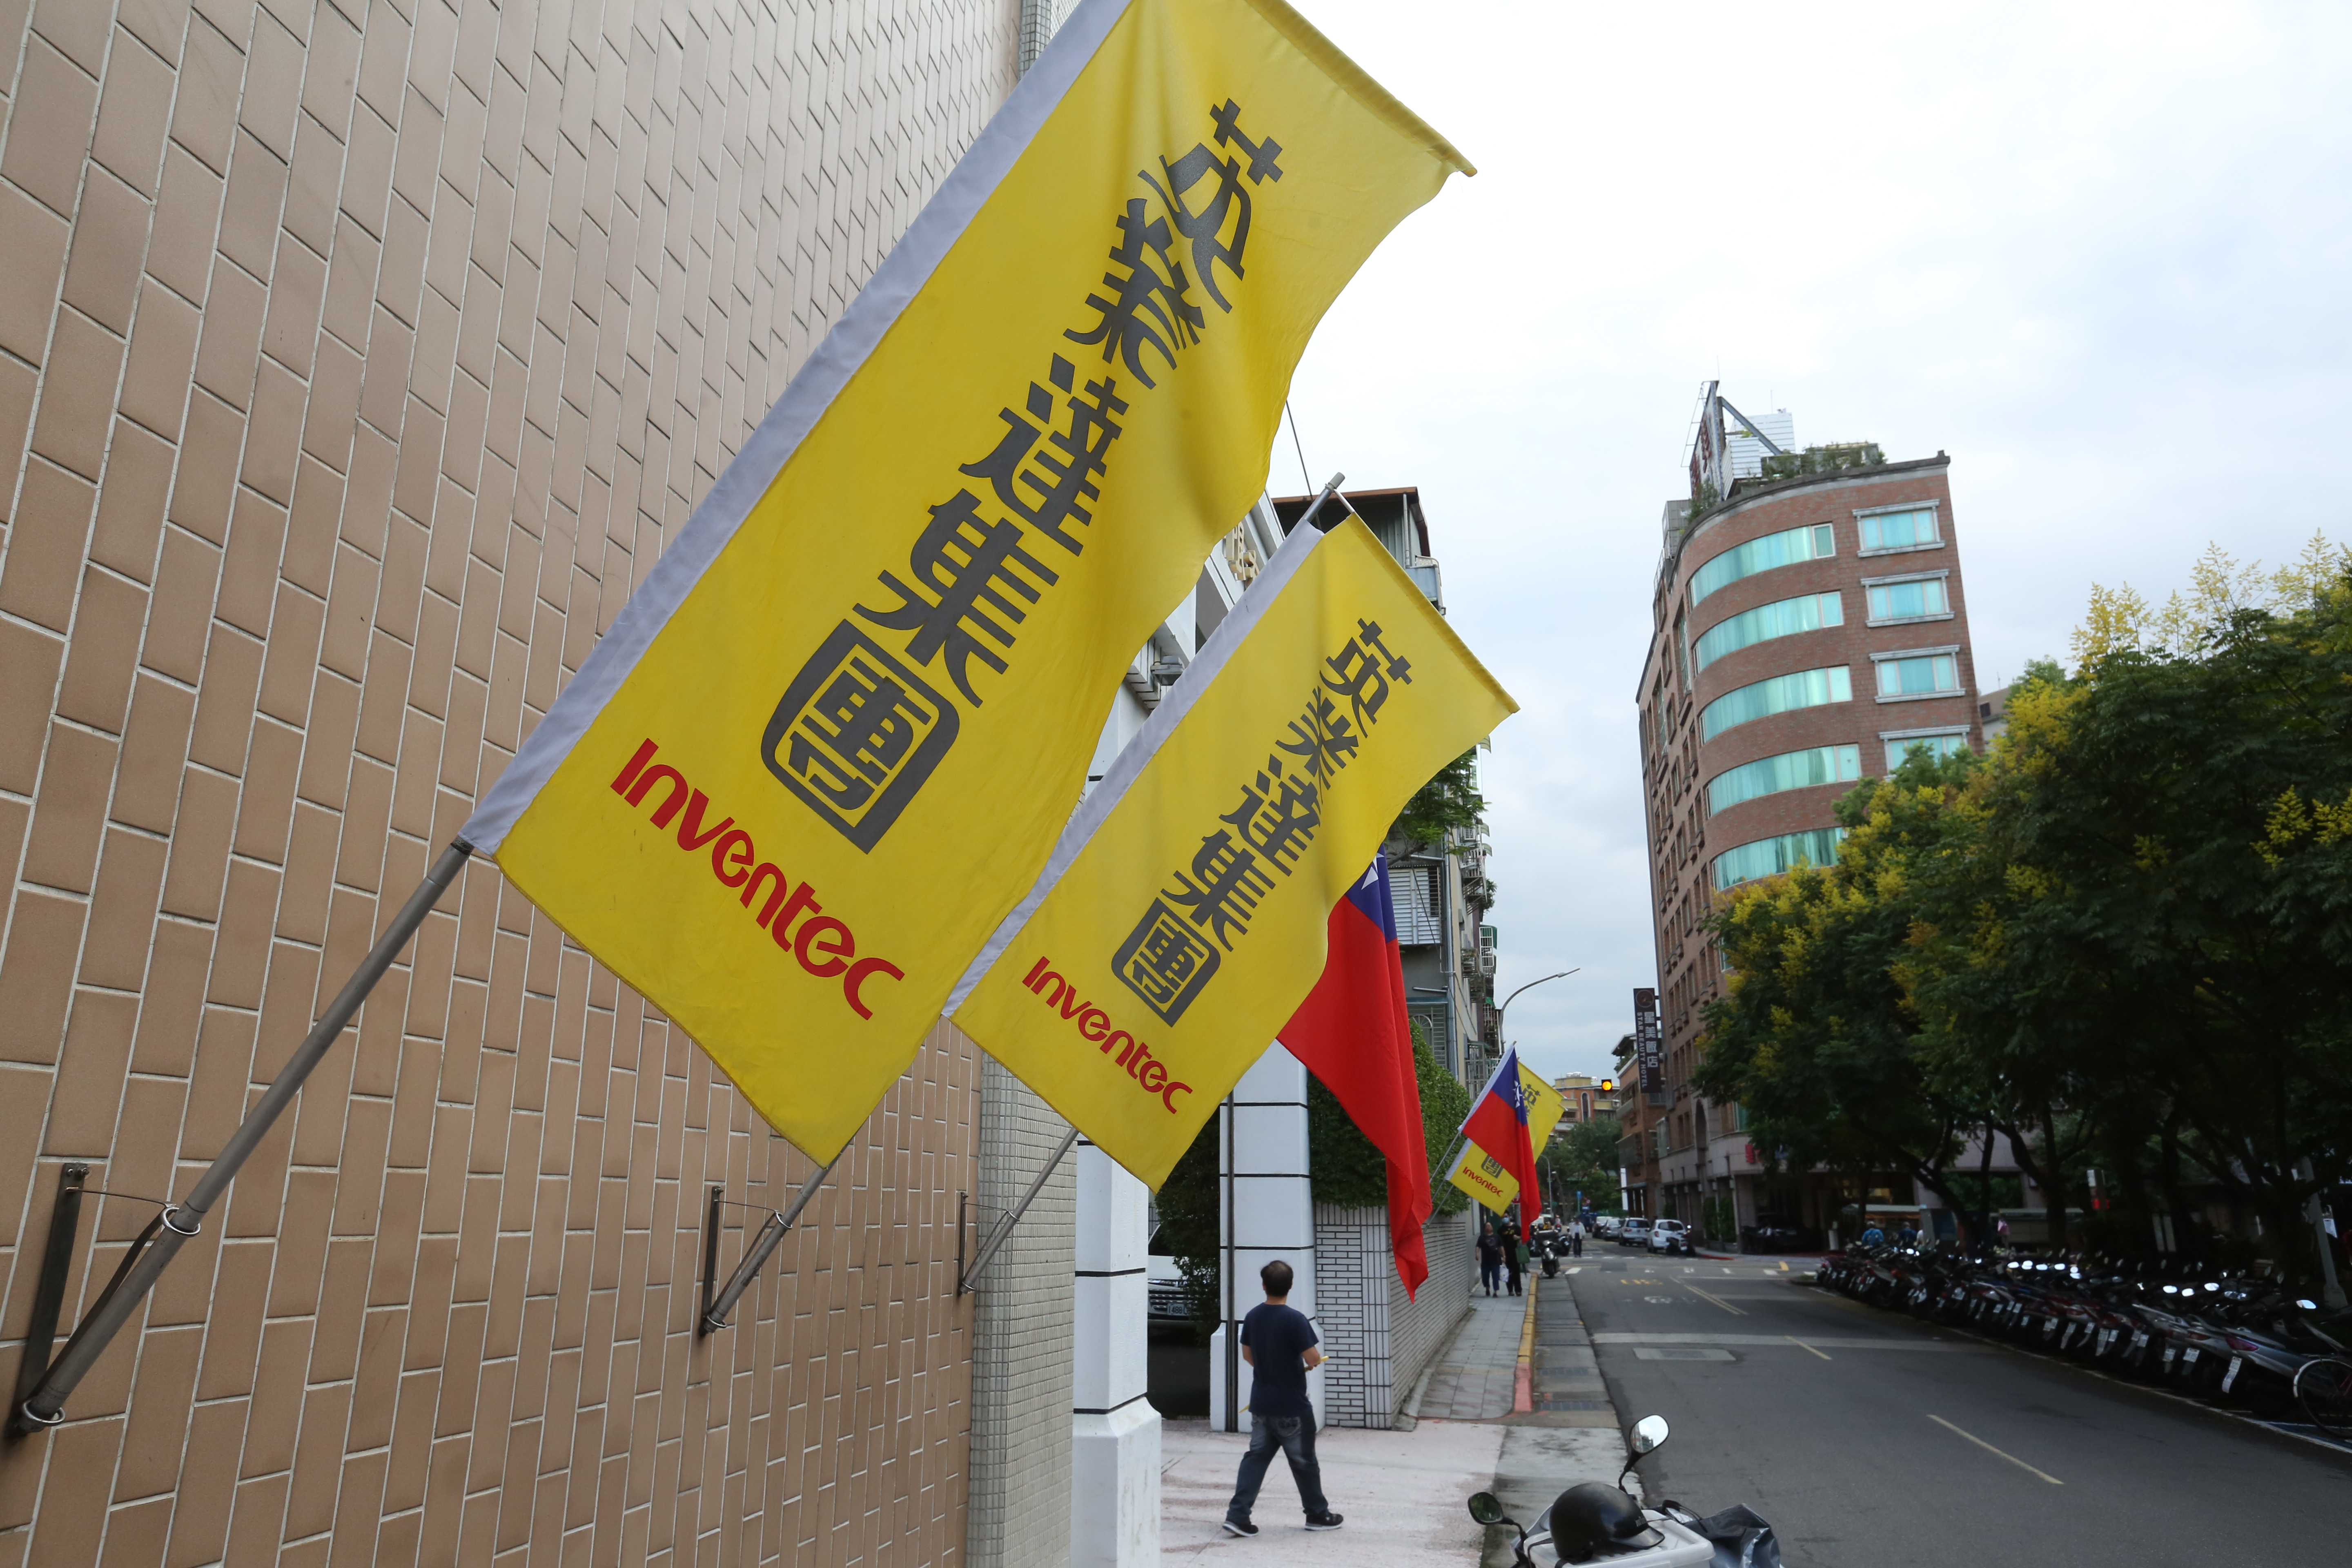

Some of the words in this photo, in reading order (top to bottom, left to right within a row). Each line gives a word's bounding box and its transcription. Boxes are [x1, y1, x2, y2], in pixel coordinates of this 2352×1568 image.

[762, 99, 1283, 854] 英業達集團
[610, 738, 905, 1020] Inventec
[1111, 619, 1412, 1027] 英業達集團
[1023, 956, 1193, 1114] Inventec
